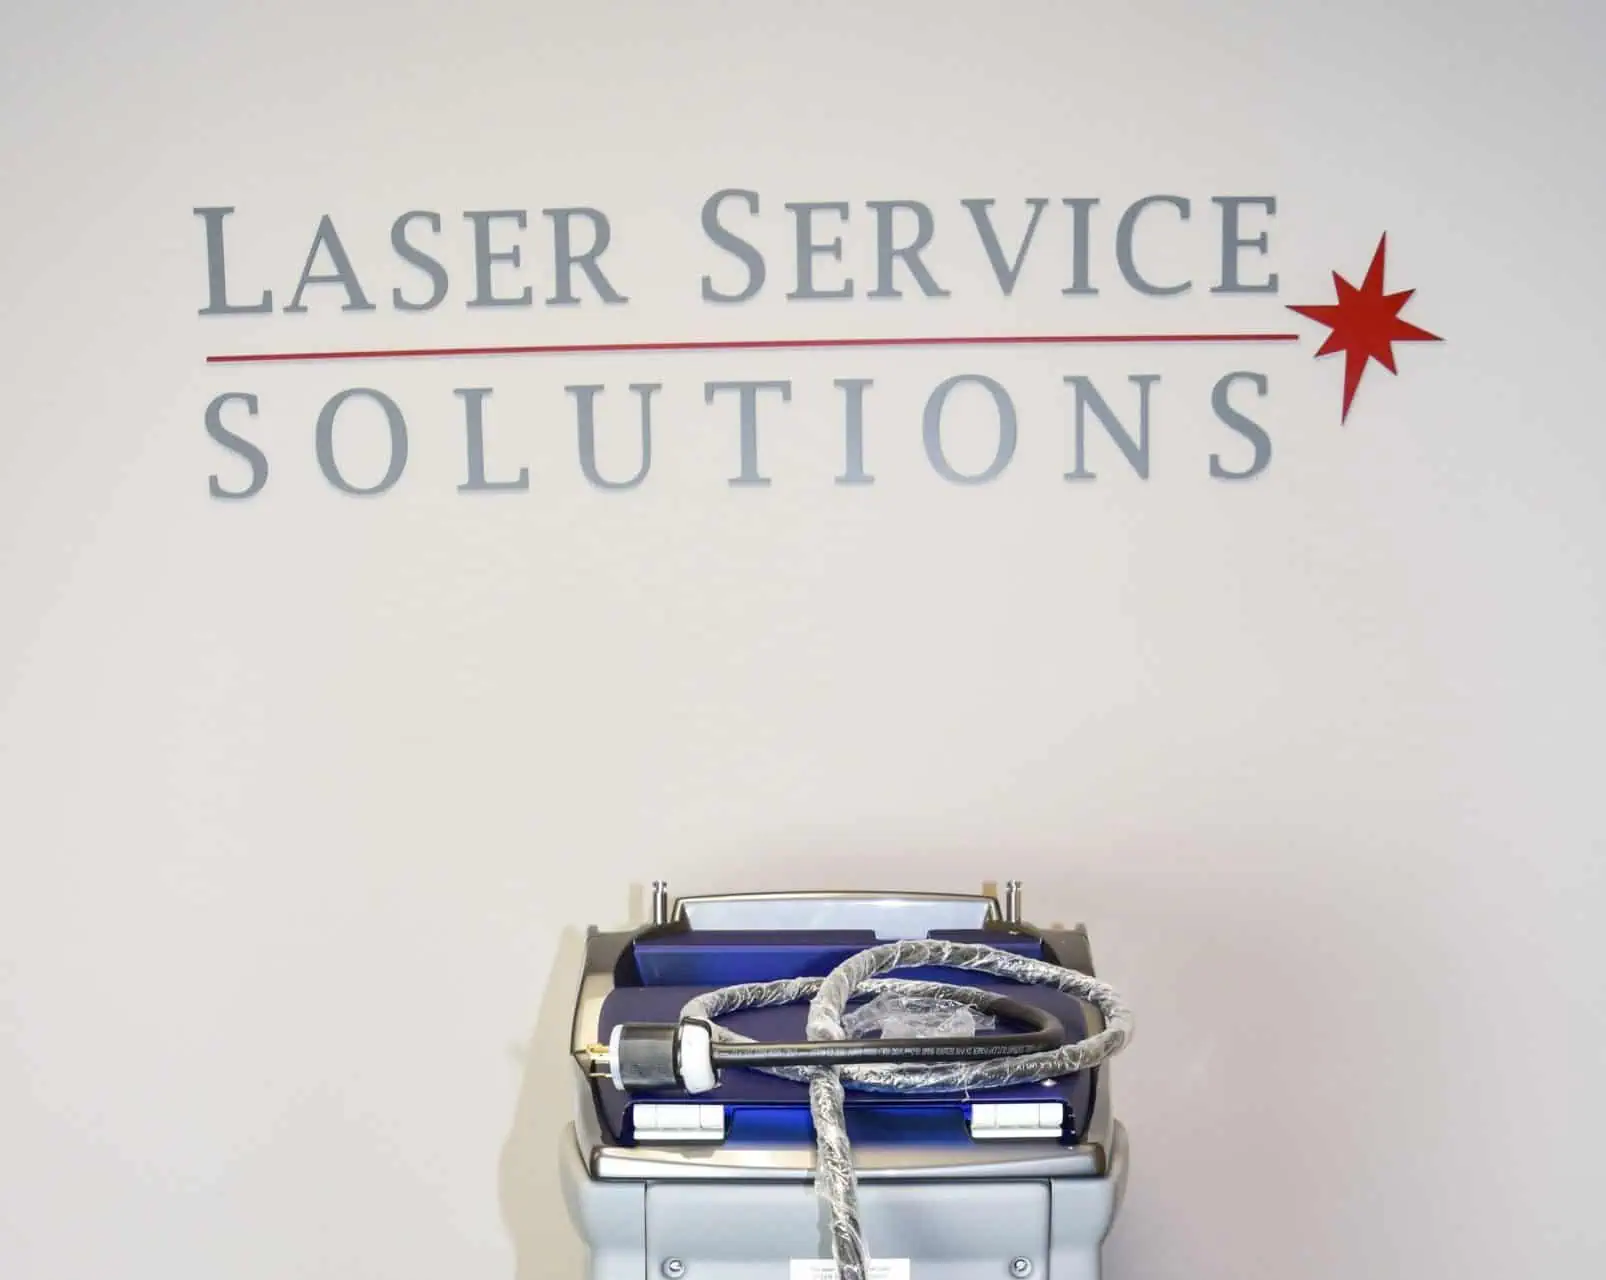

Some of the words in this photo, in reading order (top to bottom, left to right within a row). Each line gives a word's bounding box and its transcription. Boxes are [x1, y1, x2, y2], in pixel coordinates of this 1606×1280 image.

[193, 206, 629, 316] LASER
[700, 187, 1279, 303] SERVICE
[204, 371, 1272, 500] SOLUTIONS
